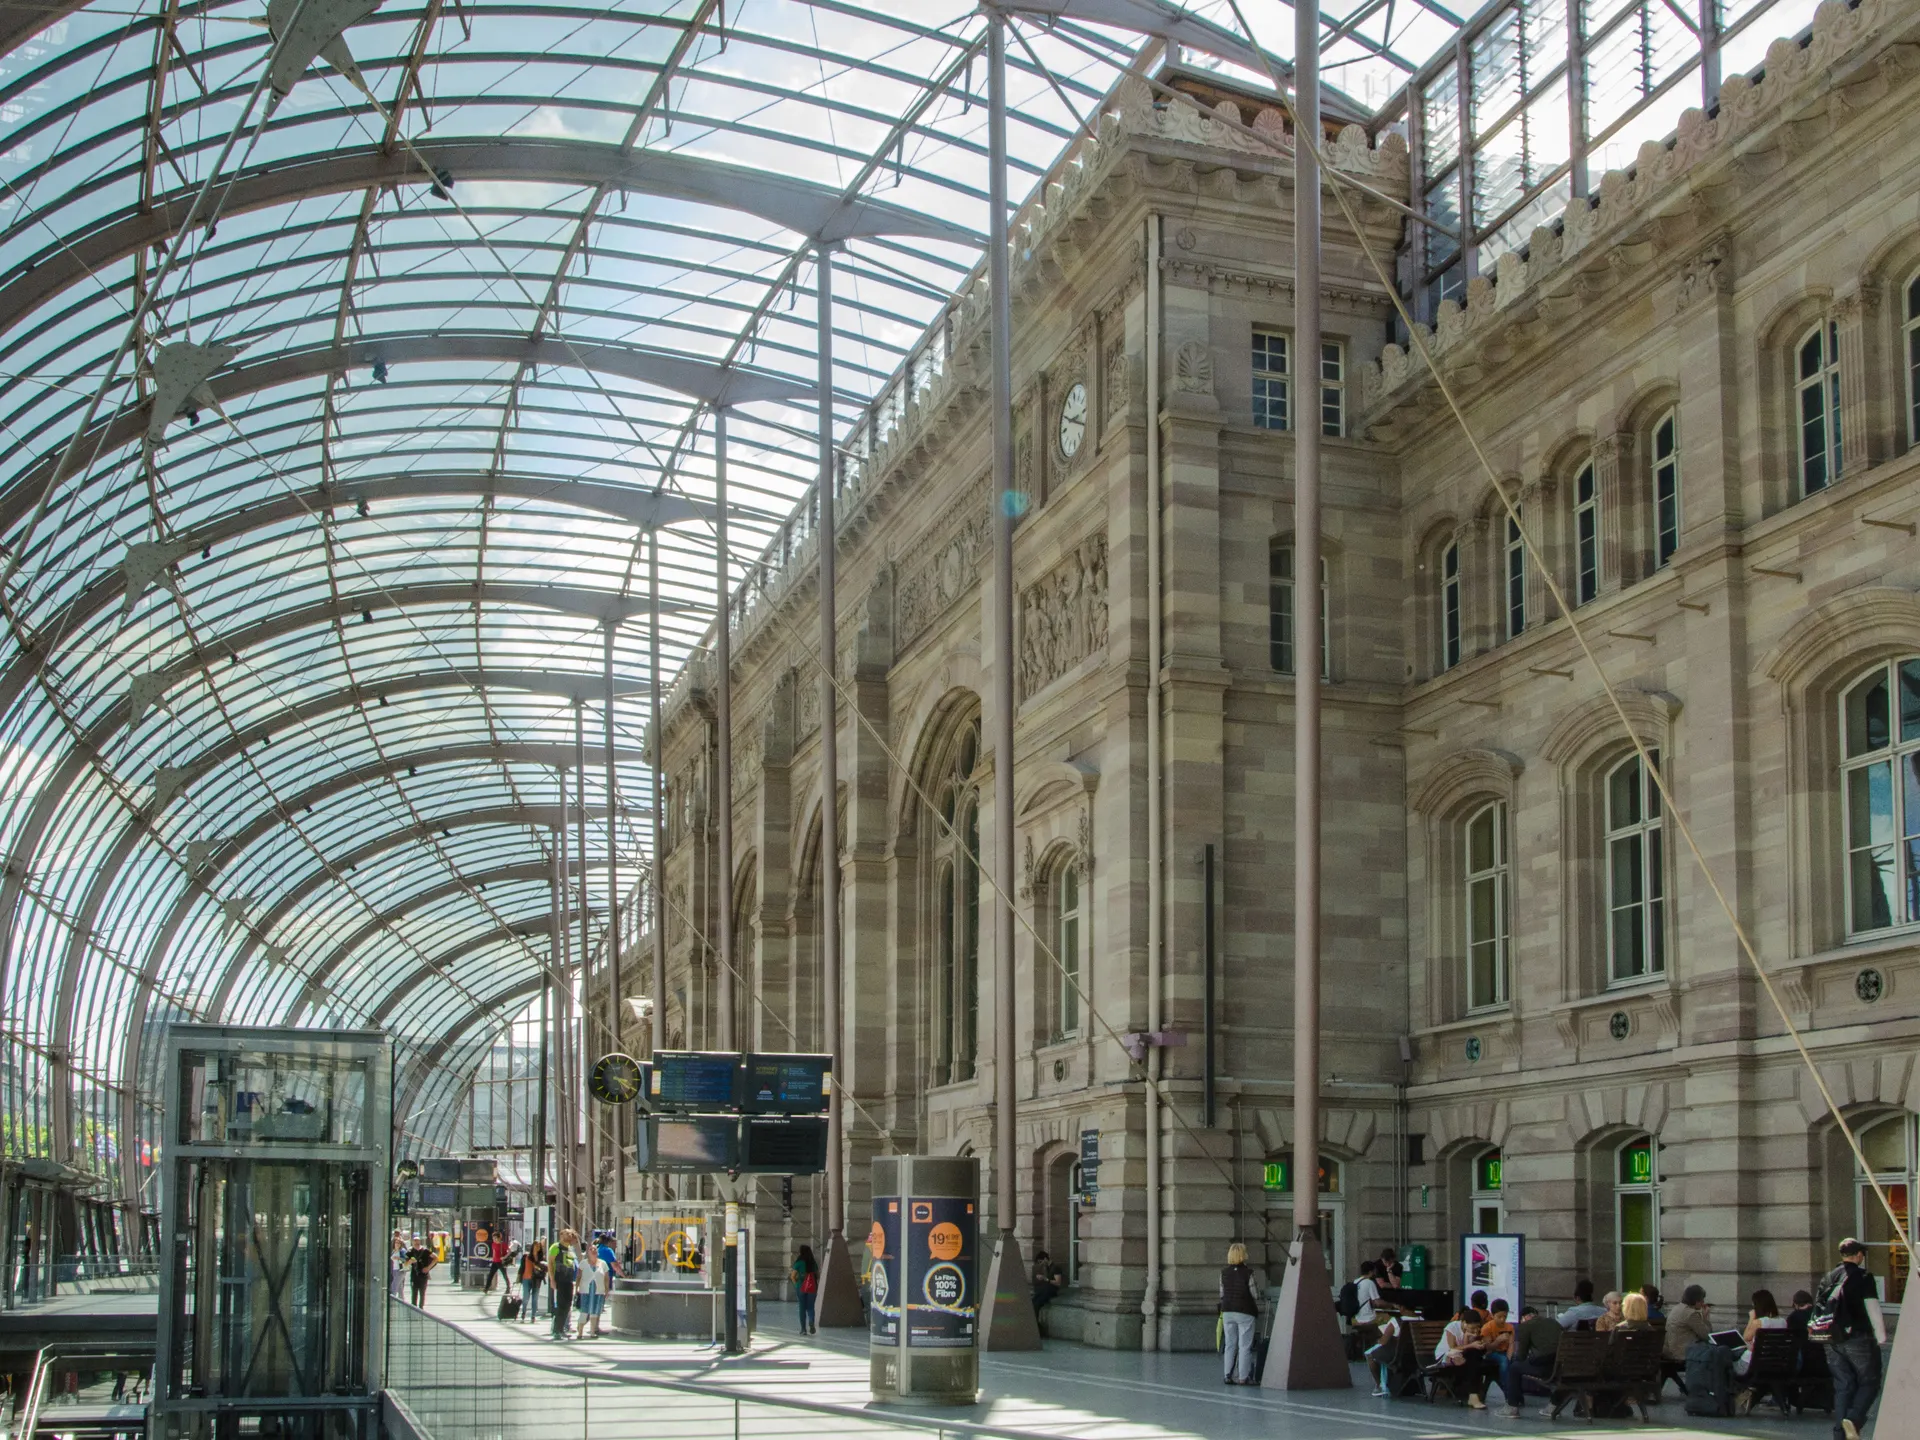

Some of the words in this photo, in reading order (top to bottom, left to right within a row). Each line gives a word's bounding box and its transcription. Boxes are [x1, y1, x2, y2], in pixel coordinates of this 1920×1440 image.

[934, 1274, 943, 1282] La
[934, 1281, 957, 1290] 100%
[935, 1289, 957, 1298] Fibre
